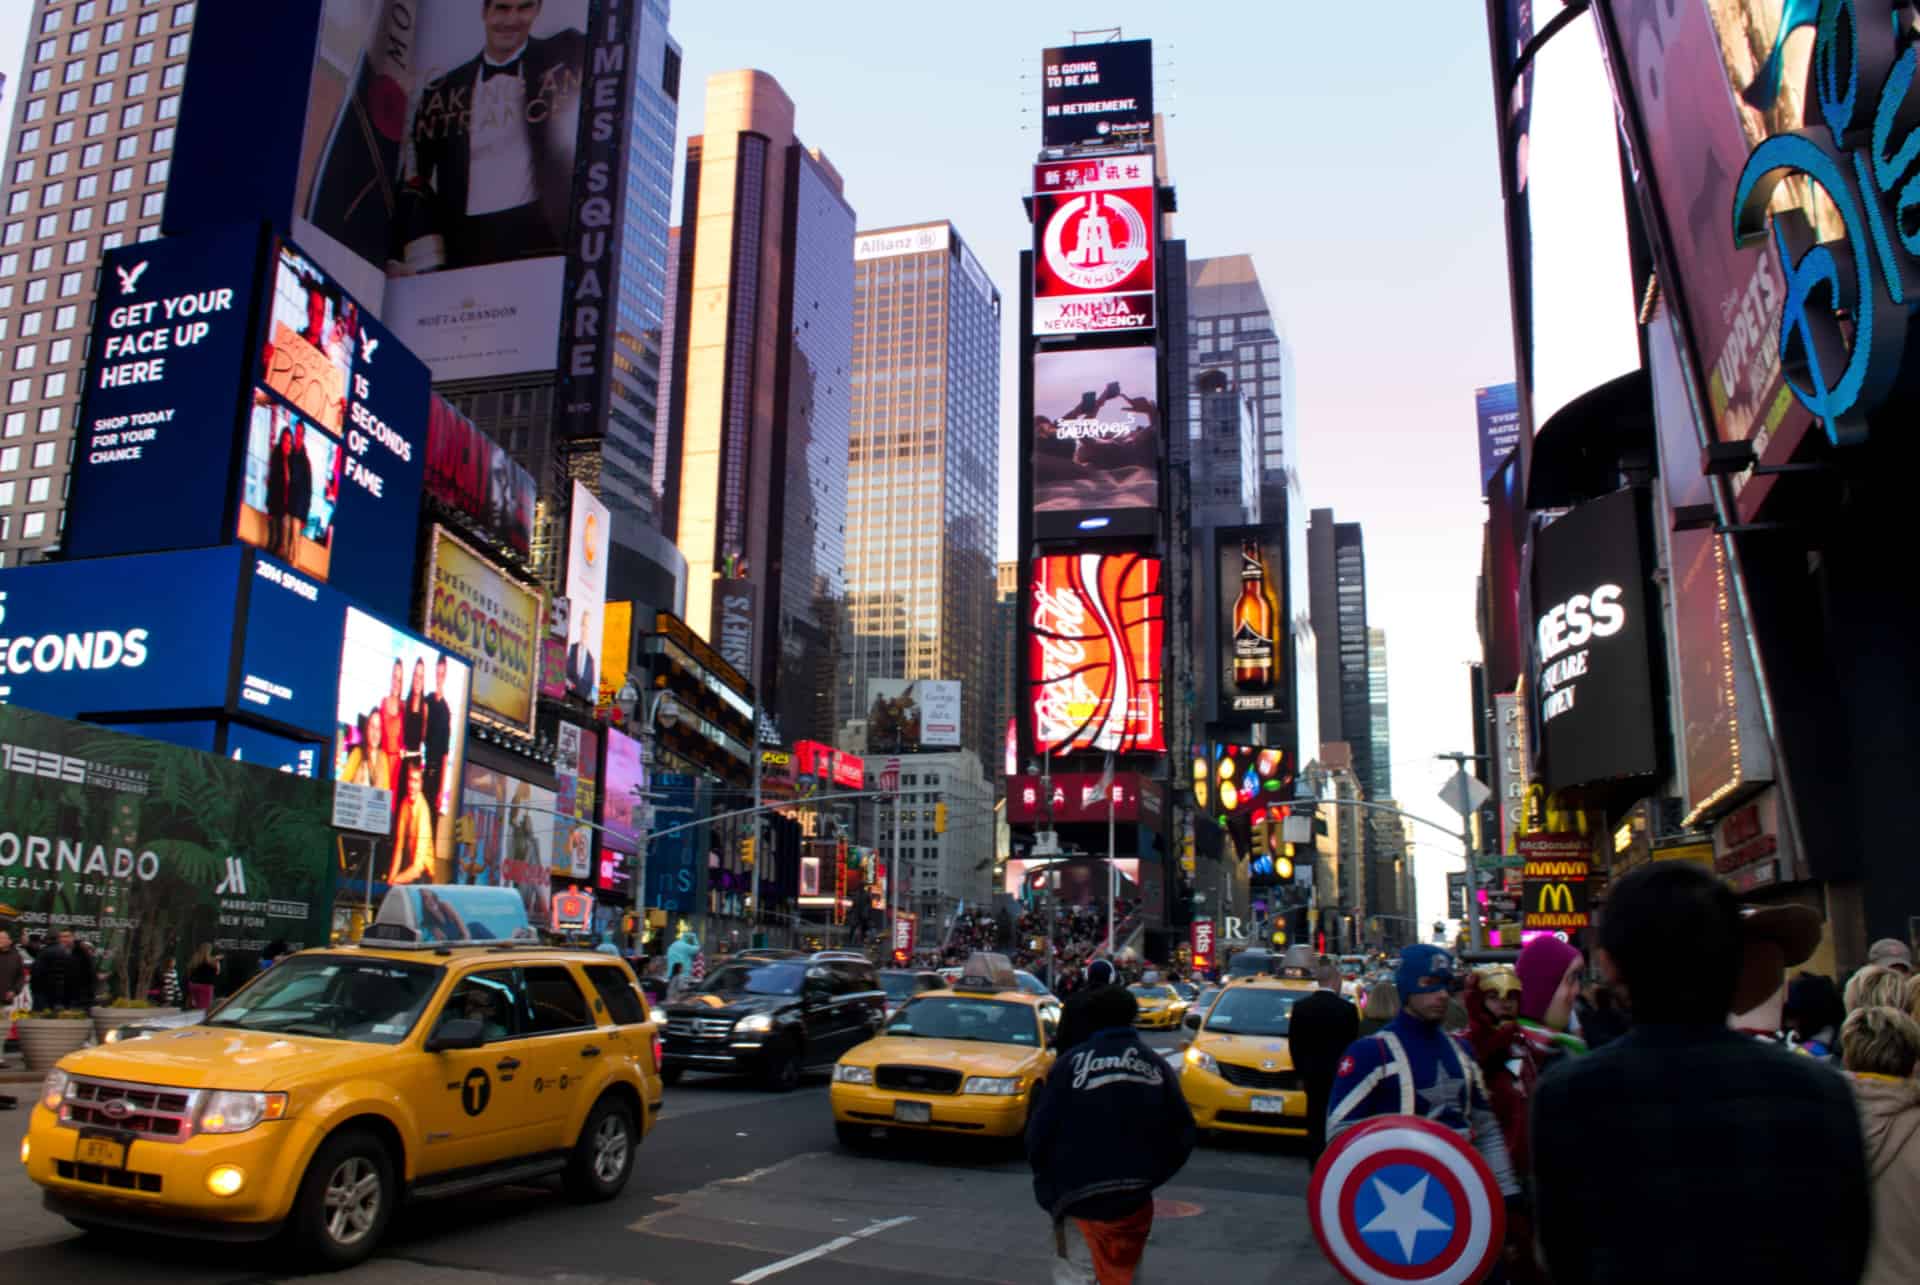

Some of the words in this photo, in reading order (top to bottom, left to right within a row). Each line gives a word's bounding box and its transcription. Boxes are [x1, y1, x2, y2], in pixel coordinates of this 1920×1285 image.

[591, 0, 626, 142] IMES
[1047, 64, 1059, 76] IS
[1061, 61, 1097, 75] GOING
[1047, 77, 1062, 88] TO
[1064, 75, 1081, 87] BE
[1082, 73, 1100, 85] AN
[1047, 105, 1060, 117] IN
[1063, 98, 1139, 115] RETIREMENT.
[861, 238, 912, 254] Allianz
[570, 162, 614, 377] SQUARE
[110, 301, 157, 329] GET
[164, 288, 233, 318] YOUR
[1060, 301, 1131, 318] XINHUA
[105, 328, 168, 359] FACE
[175, 322, 209, 348] UP
[100, 359, 165, 388] HERE
[353, 373, 370, 400] 15
[93, 414, 128, 432] SHOP
[130, 408, 175, 427] TODAY
[351, 401, 412, 462] SECONDS
[92, 432, 118, 448] FOR
[120, 428, 156, 445] YOUR
[348, 429, 370, 457] OF
[89, 446, 142, 465] CHANCE
[344, 459, 384, 498] FAME
[431, 586, 529, 676] MOTOWN
[1, 743, 87, 784] 1535
[1505, 707, 1523, 824] PALAC
[73, 882, 129, 897] TRUST
[1195, 923, 1213, 954] tkts
[1071, 1047, 1163, 1089] Yankees
